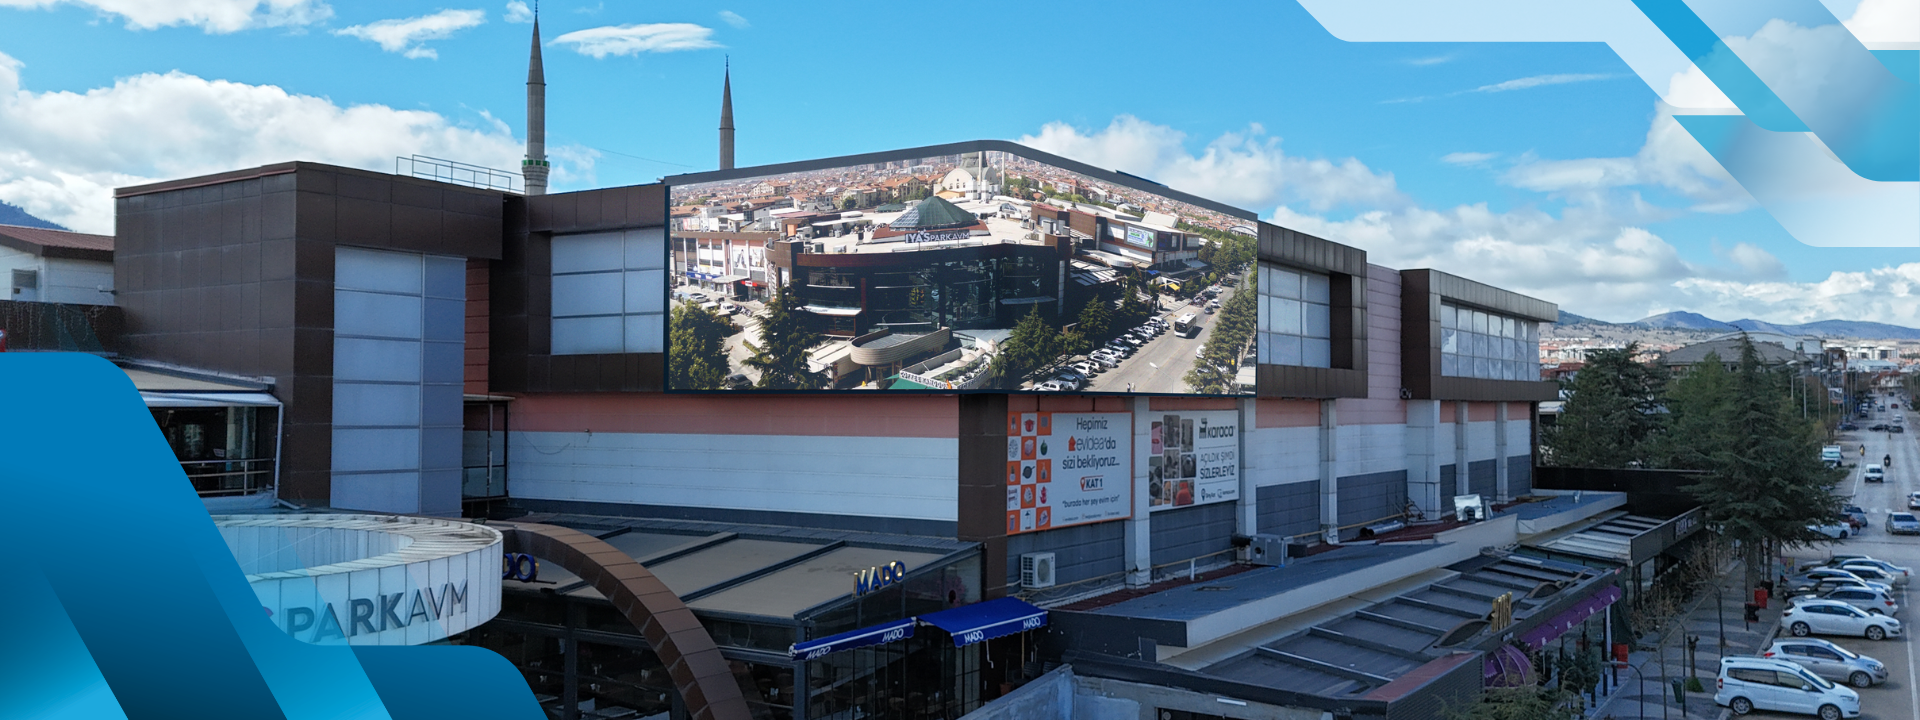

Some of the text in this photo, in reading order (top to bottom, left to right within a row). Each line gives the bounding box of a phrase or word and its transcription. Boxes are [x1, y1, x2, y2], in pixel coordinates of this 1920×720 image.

[1076, 416, 1108, 432] Hepimiz
[1207, 425, 1234, 439] karaca
[1062, 455, 1076, 469] sizi
[1200, 452, 1220, 465] AÇILDIK
[1200, 463, 1235, 480] SİZLERLEYİZ
[854, 560, 906, 597] MADO
[1022, 616, 1041, 629] MADO
[881, 628, 904, 642] MADO
[963, 630, 984, 644] MADO
[805, 645, 832, 660] MADO
